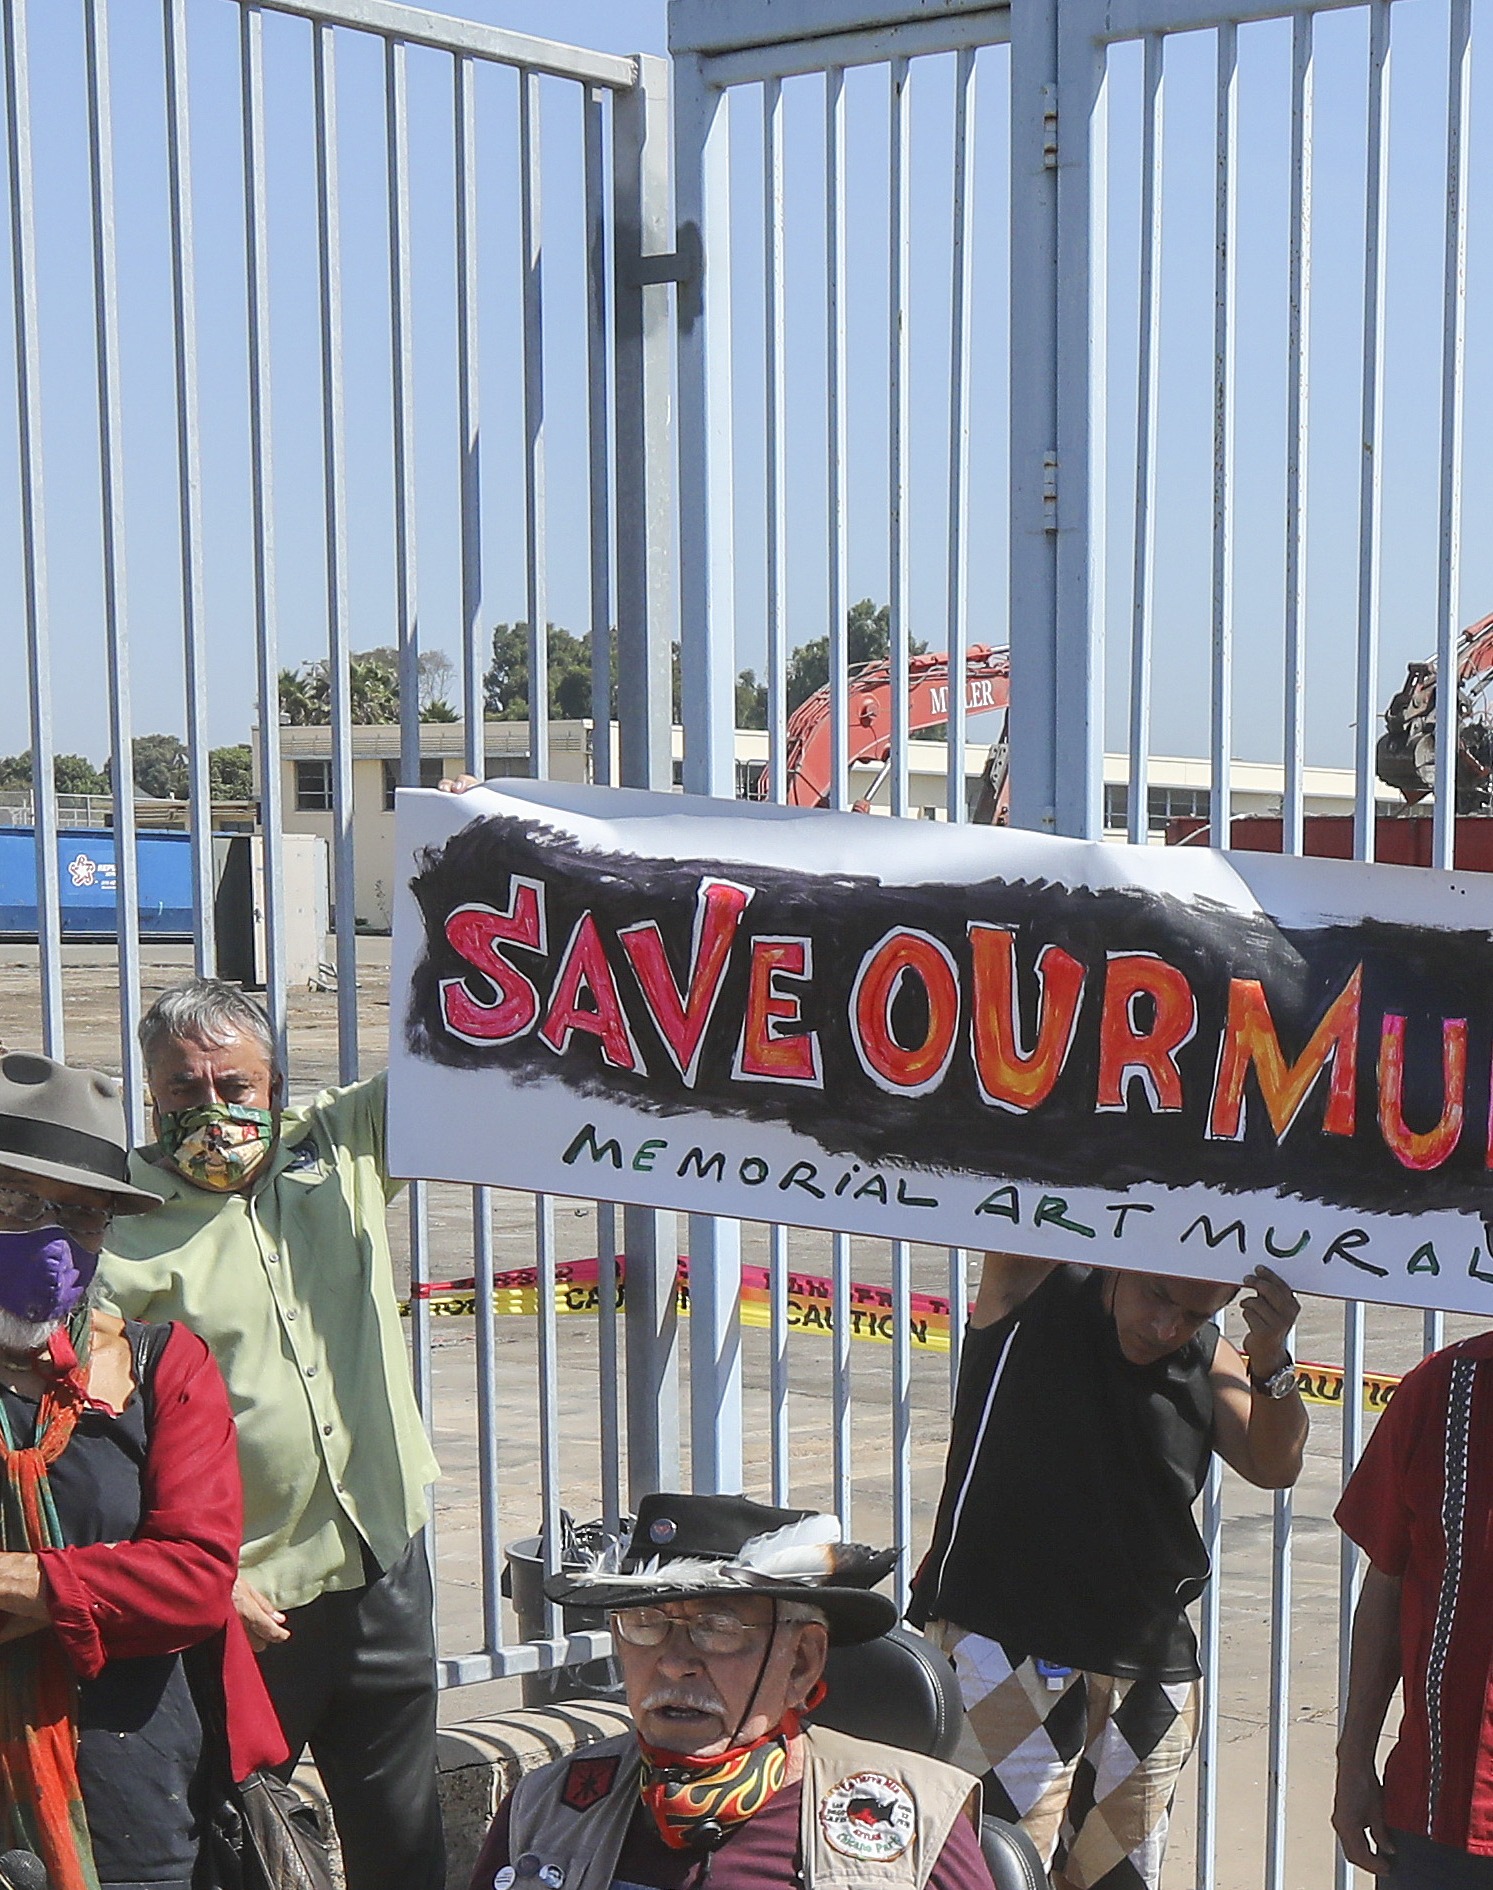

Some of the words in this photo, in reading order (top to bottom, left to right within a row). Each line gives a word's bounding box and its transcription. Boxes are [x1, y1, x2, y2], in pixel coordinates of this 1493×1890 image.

[439, 874, 824, 1089] SAVE
[848, 920, 1199, 1115] OUR
[975, 1185, 1155, 1239] ART
